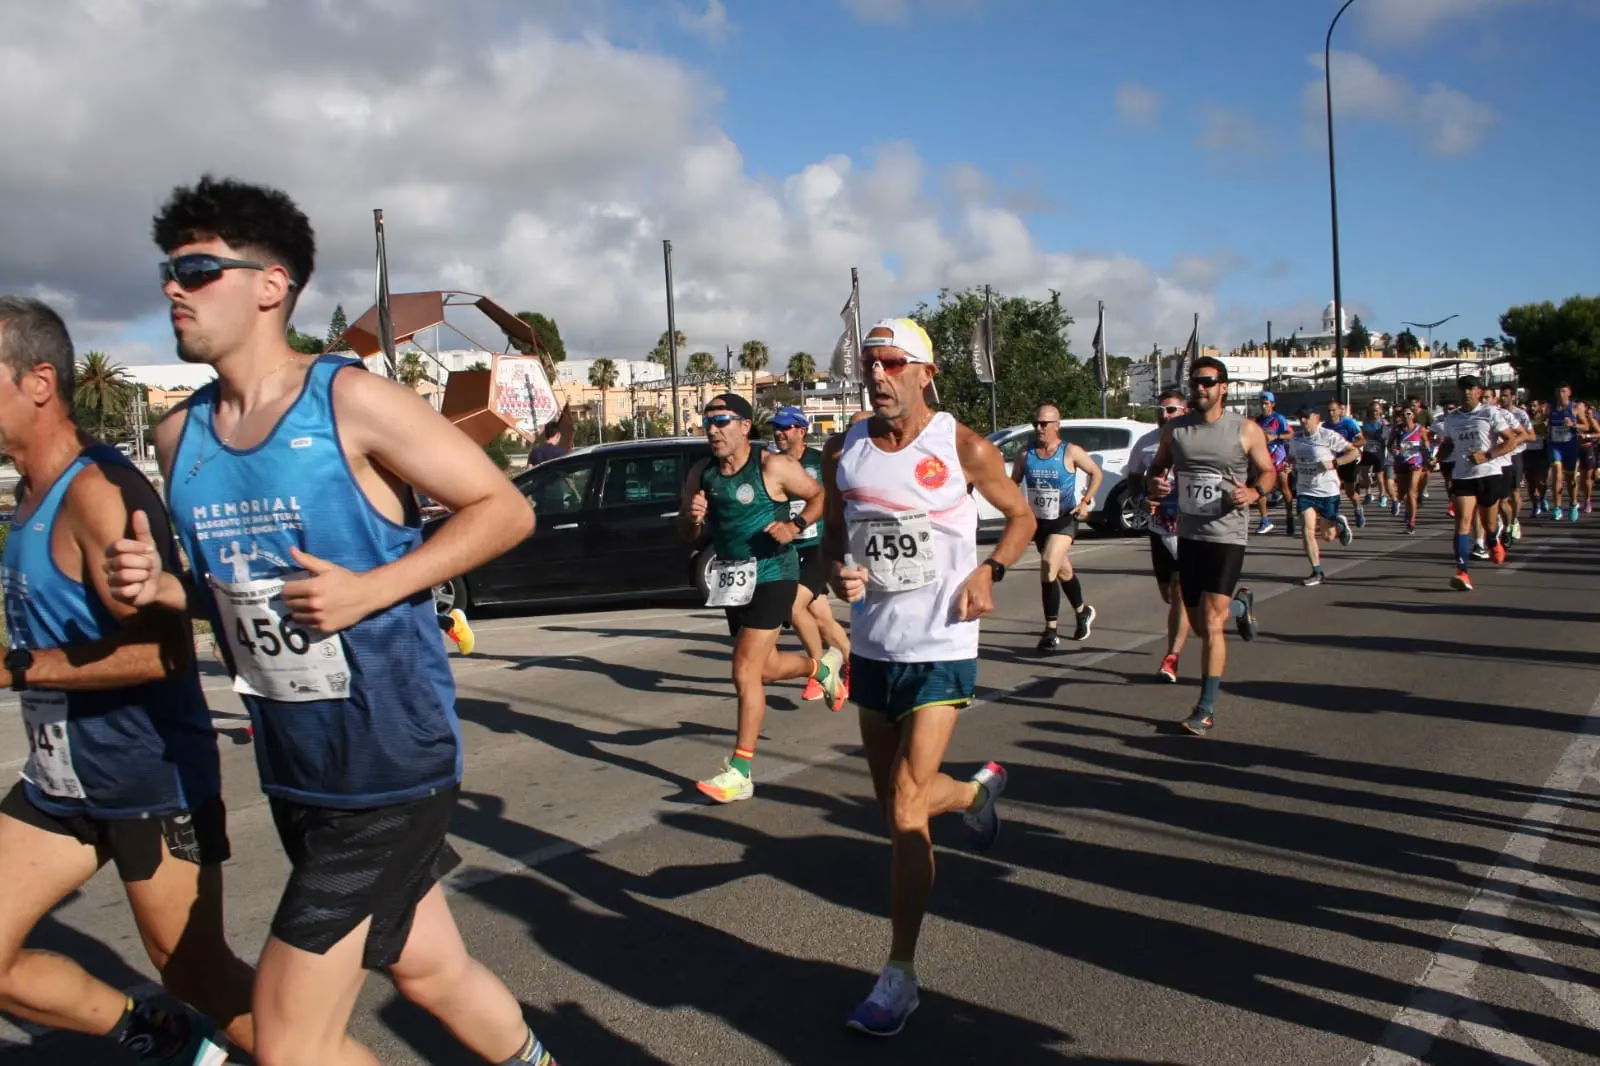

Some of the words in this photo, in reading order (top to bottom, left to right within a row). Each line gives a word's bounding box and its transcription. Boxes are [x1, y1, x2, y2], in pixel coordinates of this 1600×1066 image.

[1033, 497, 1053, 508] 497
[1185, 484, 1213, 500] 176
[192, 496, 301, 519] MEMORIAL
[865, 534, 918, 562] 459
[718, 570, 747, 589] 853
[235, 613, 311, 657] 456
